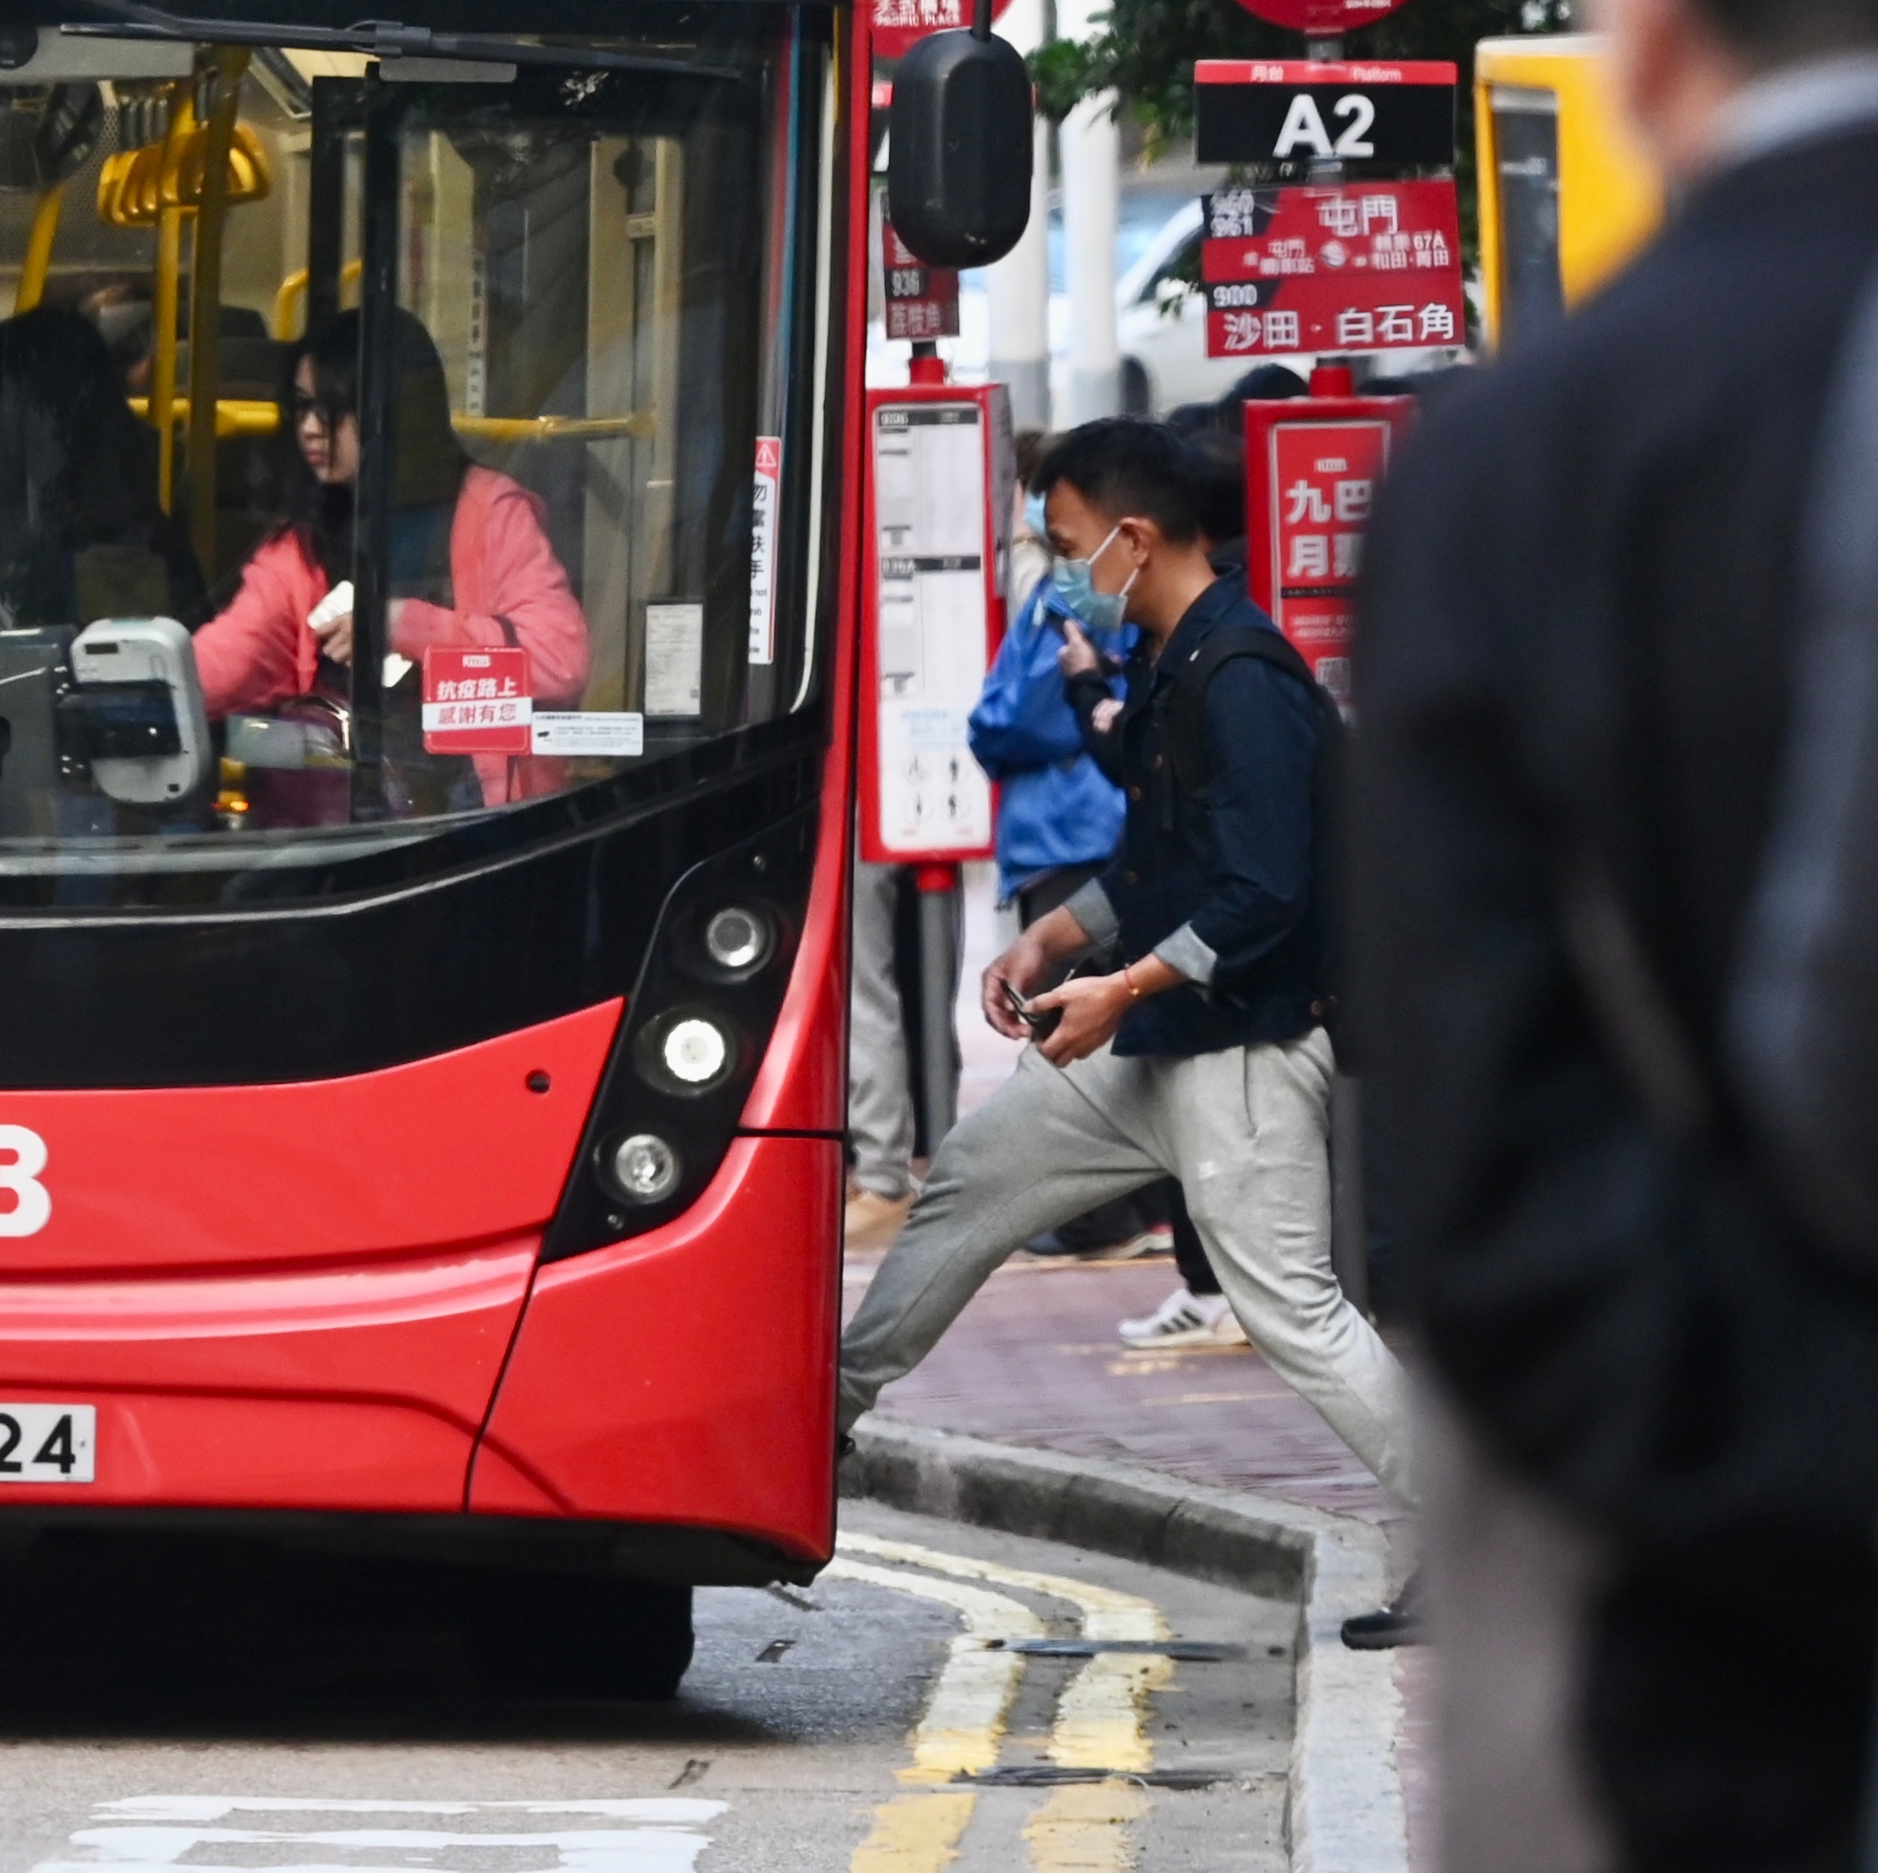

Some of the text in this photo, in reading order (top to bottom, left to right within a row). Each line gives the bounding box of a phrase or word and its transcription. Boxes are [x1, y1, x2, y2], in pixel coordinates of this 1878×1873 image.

[1351, 66, 1403, 82] Platform
[1273, 93, 1375, 158] A2
[1316, 193, 1399, 238] 屯門
[1213, 284, 1259, 308] 900
[1285, 478, 1372, 525] 九巴
[436, 676, 518, 701] 抗疫路上
[437, 702, 518, 725] 感謝有您
